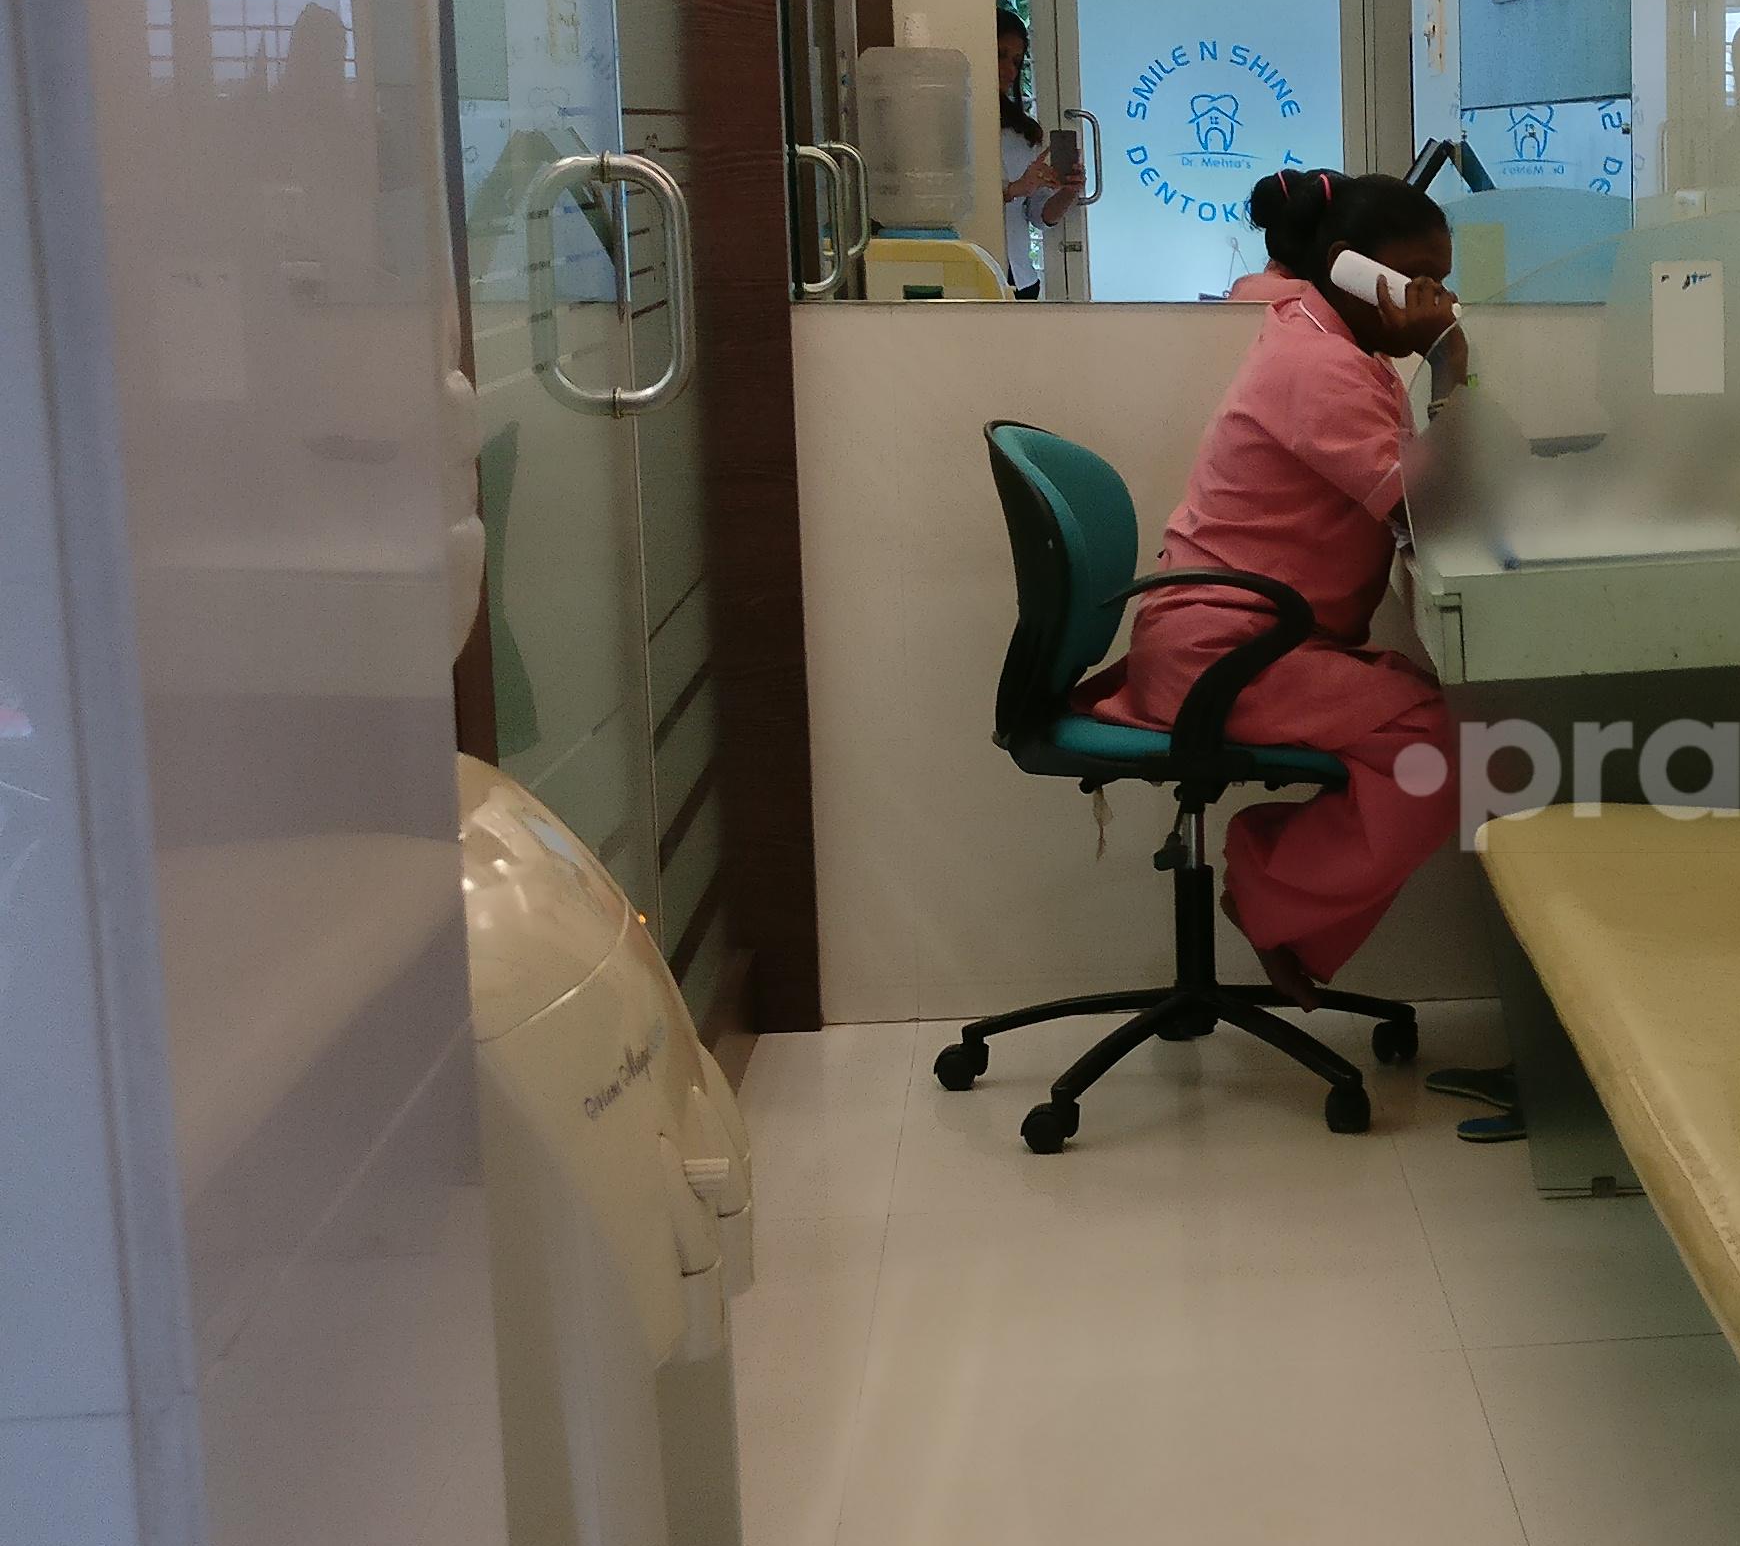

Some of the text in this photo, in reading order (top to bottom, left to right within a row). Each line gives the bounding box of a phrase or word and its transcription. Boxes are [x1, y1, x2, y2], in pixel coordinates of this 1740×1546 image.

[1126, 41, 1301, 120] SMILE N SHINE
